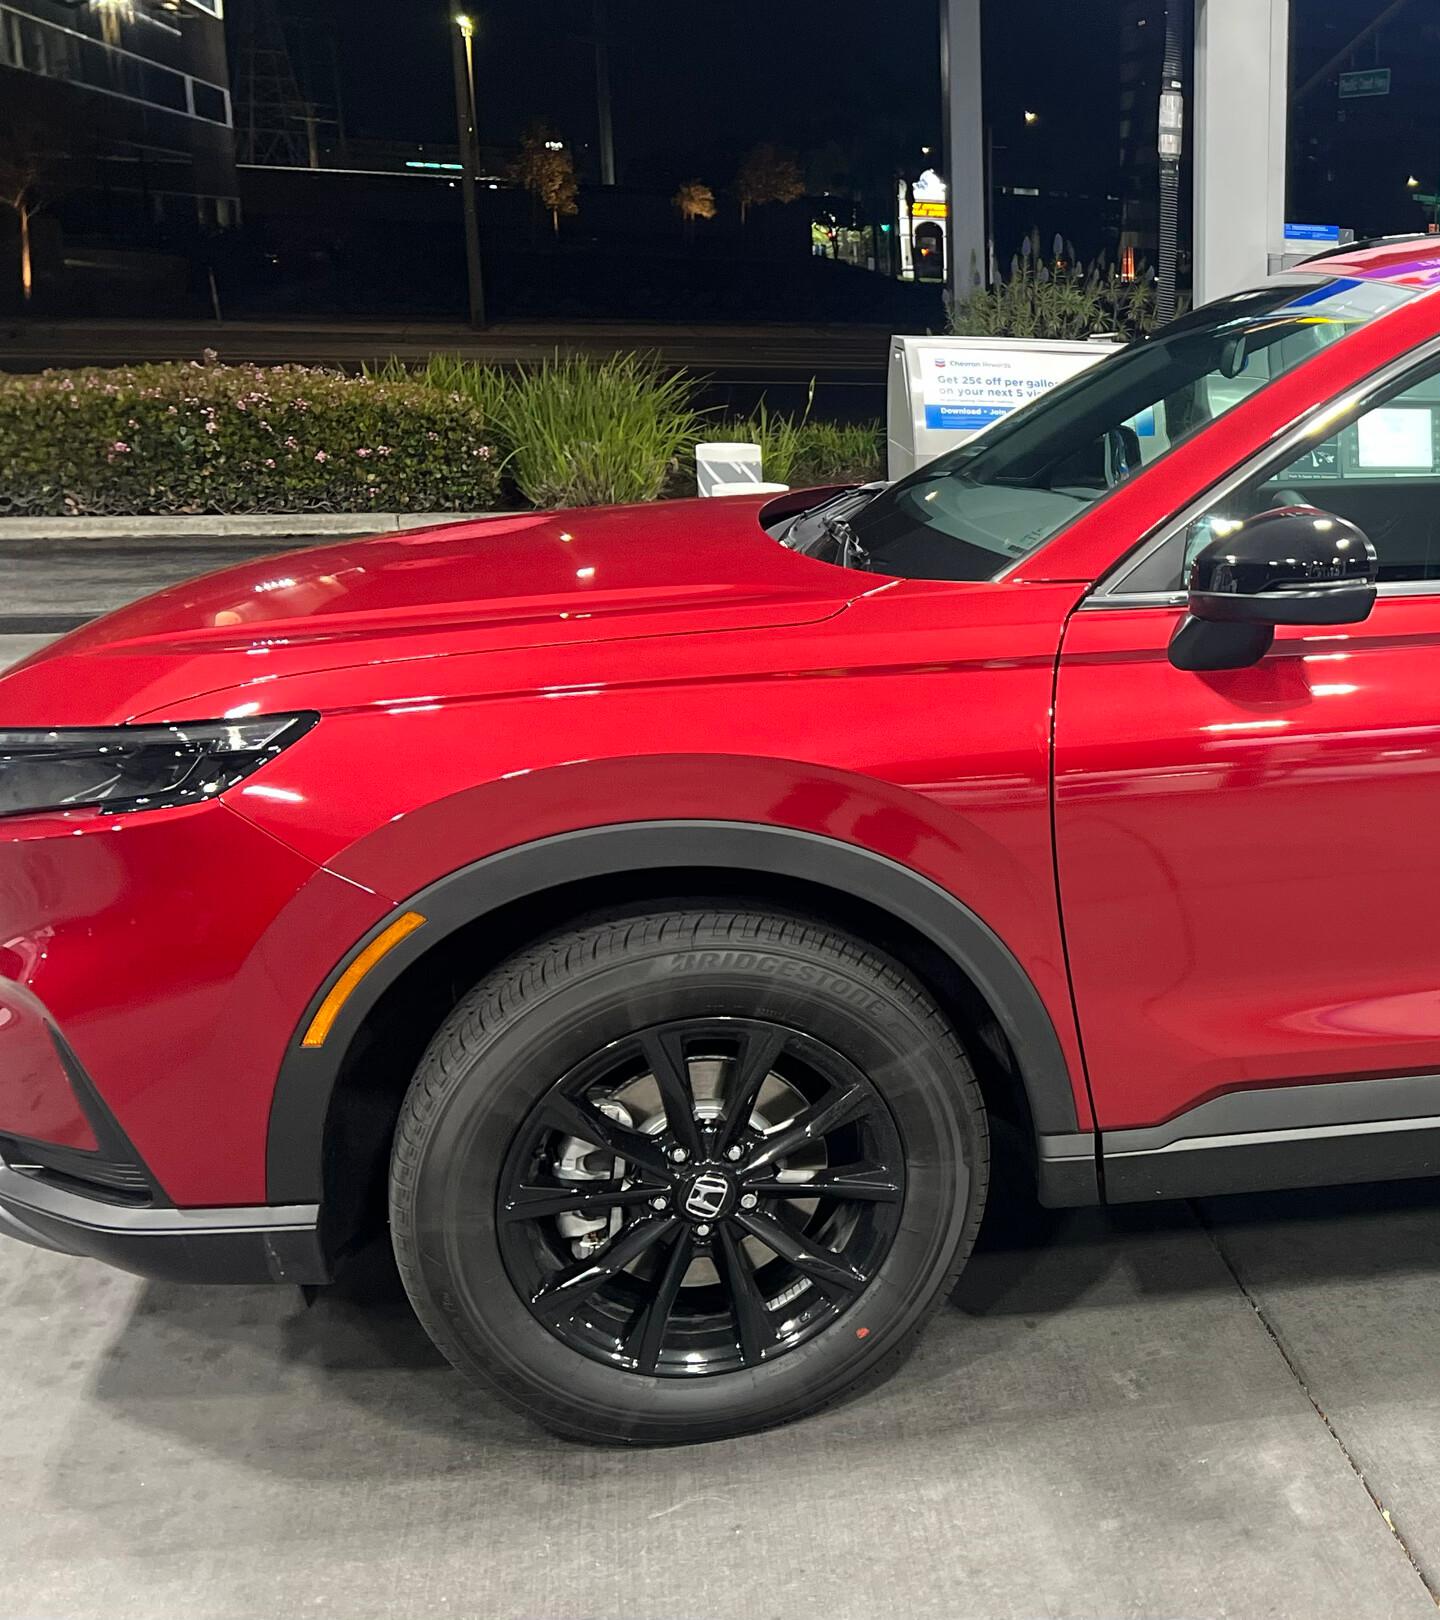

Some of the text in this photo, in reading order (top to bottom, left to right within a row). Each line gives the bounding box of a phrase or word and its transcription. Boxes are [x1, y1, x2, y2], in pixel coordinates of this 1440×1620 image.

[950, 360, 981, 368] Chevron
[938, 375, 958, 384] Get
[962, 376, 982, 385] 25¢
[985, 377, 1002, 386] off
[1005, 379, 1024, 388] per
[939, 387, 954, 395] on
[959, 388, 984, 397] your
[987, 389, 1013, 397] next
[1016, 389, 1024, 397] 5
[941, 407, 1007, 416] Download Join
[671, 951, 887, 1017] BRIDGESTONE
